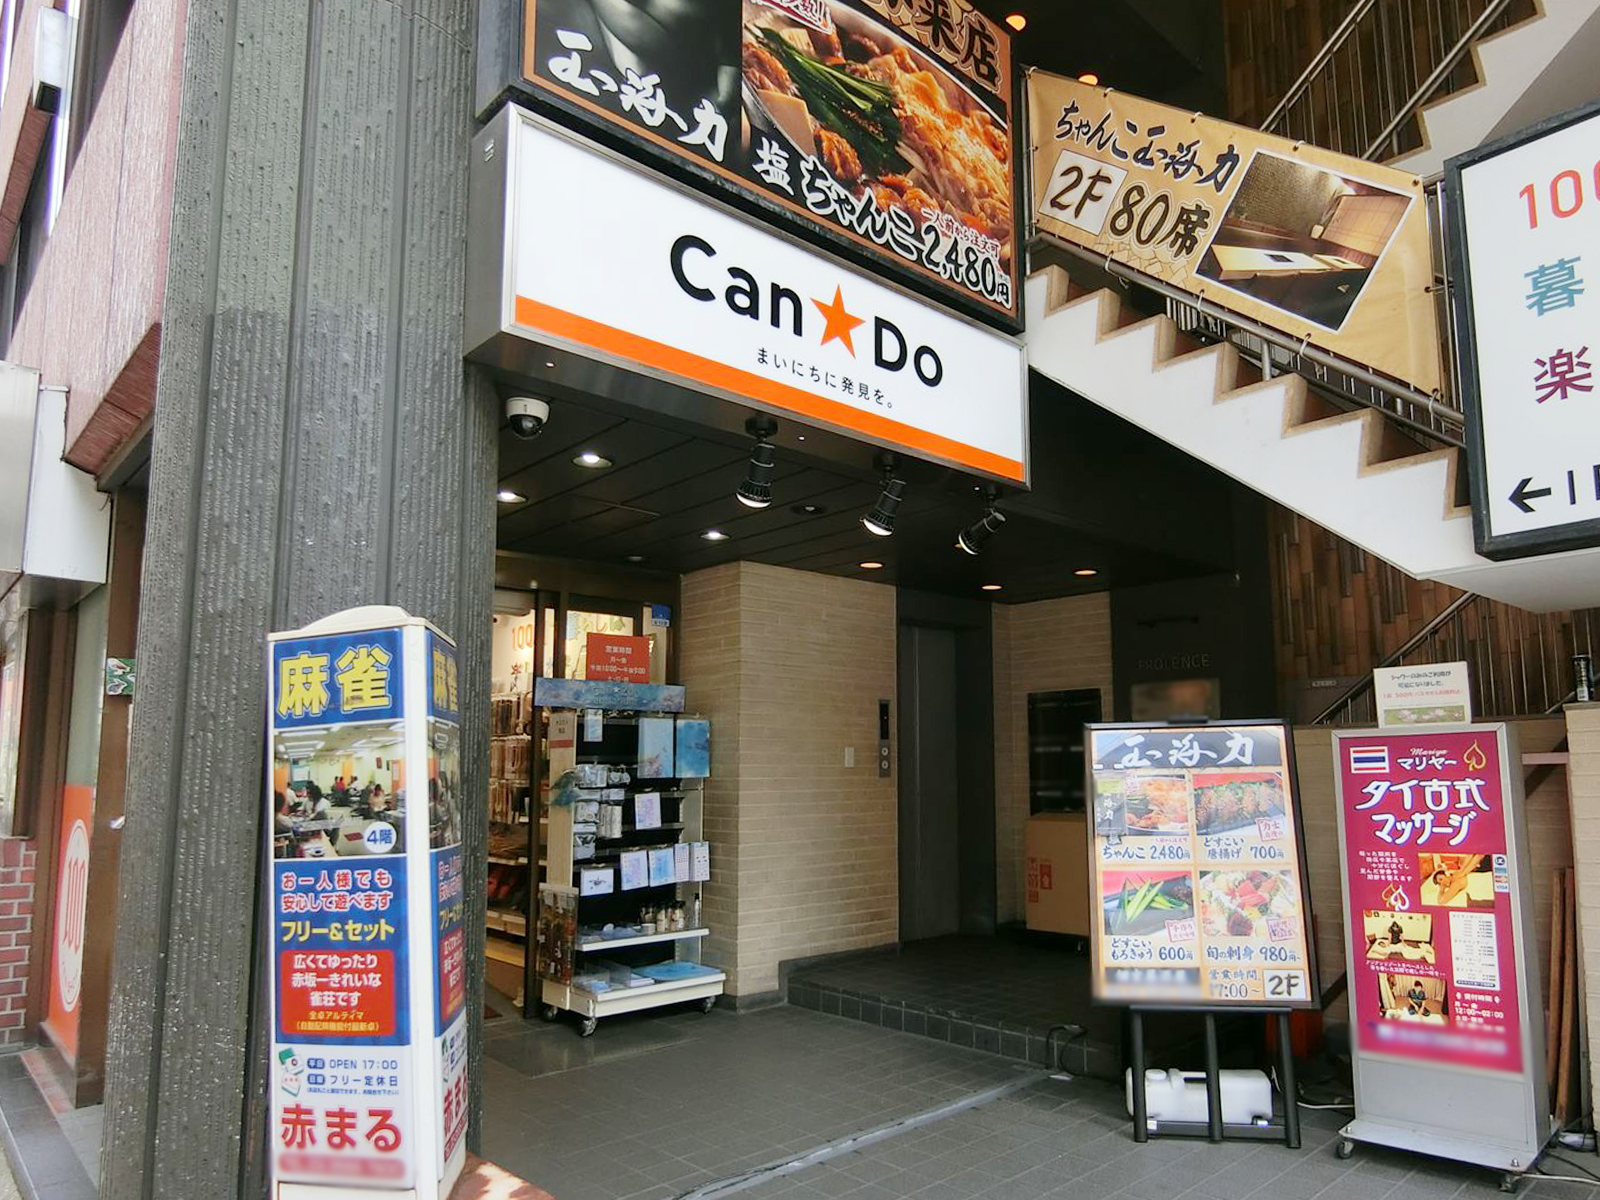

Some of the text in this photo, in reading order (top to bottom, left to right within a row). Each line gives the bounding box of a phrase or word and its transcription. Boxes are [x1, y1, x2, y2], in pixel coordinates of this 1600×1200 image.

[1049, 165, 1113, 218] 2F
[1519, 169, 1600, 230] 10
[1523, 256, 1586, 318] 暮
[757, 347, 896, 409] まいにちに発見を。
[1533, 346, 1595, 404] 楽
[278, 645, 392, 719] 麻雀
[1397, 757, 1458, 770] マリヤー
[1355, 778, 1490, 811] タイ古式
[366, 829, 393, 845] 4階
[1371, 811, 1477, 846] マッサージ
[1102, 846, 1146, 859] ちゃんこ
[1203, 837, 1245, 847] どすこい
[1207, 847, 1243, 859] 唐揚げ
[280, 868, 392, 890] お一人様でも
[281, 891, 393, 912] 安心して遊べます
[1111, 938, 1152, 948] どすこい
[293, 953, 378, 970] 広くてゆったり
[1208, 970, 1258, 981] 営業時間
[1268, 975, 1300, 997] 2F
[309, 991, 362, 1007] 雀荘です
[329, 1059, 357, 1069] OPEN
[362, 1060, 398, 1070] 17:00
[280, 1103, 402, 1152] 赤まる
